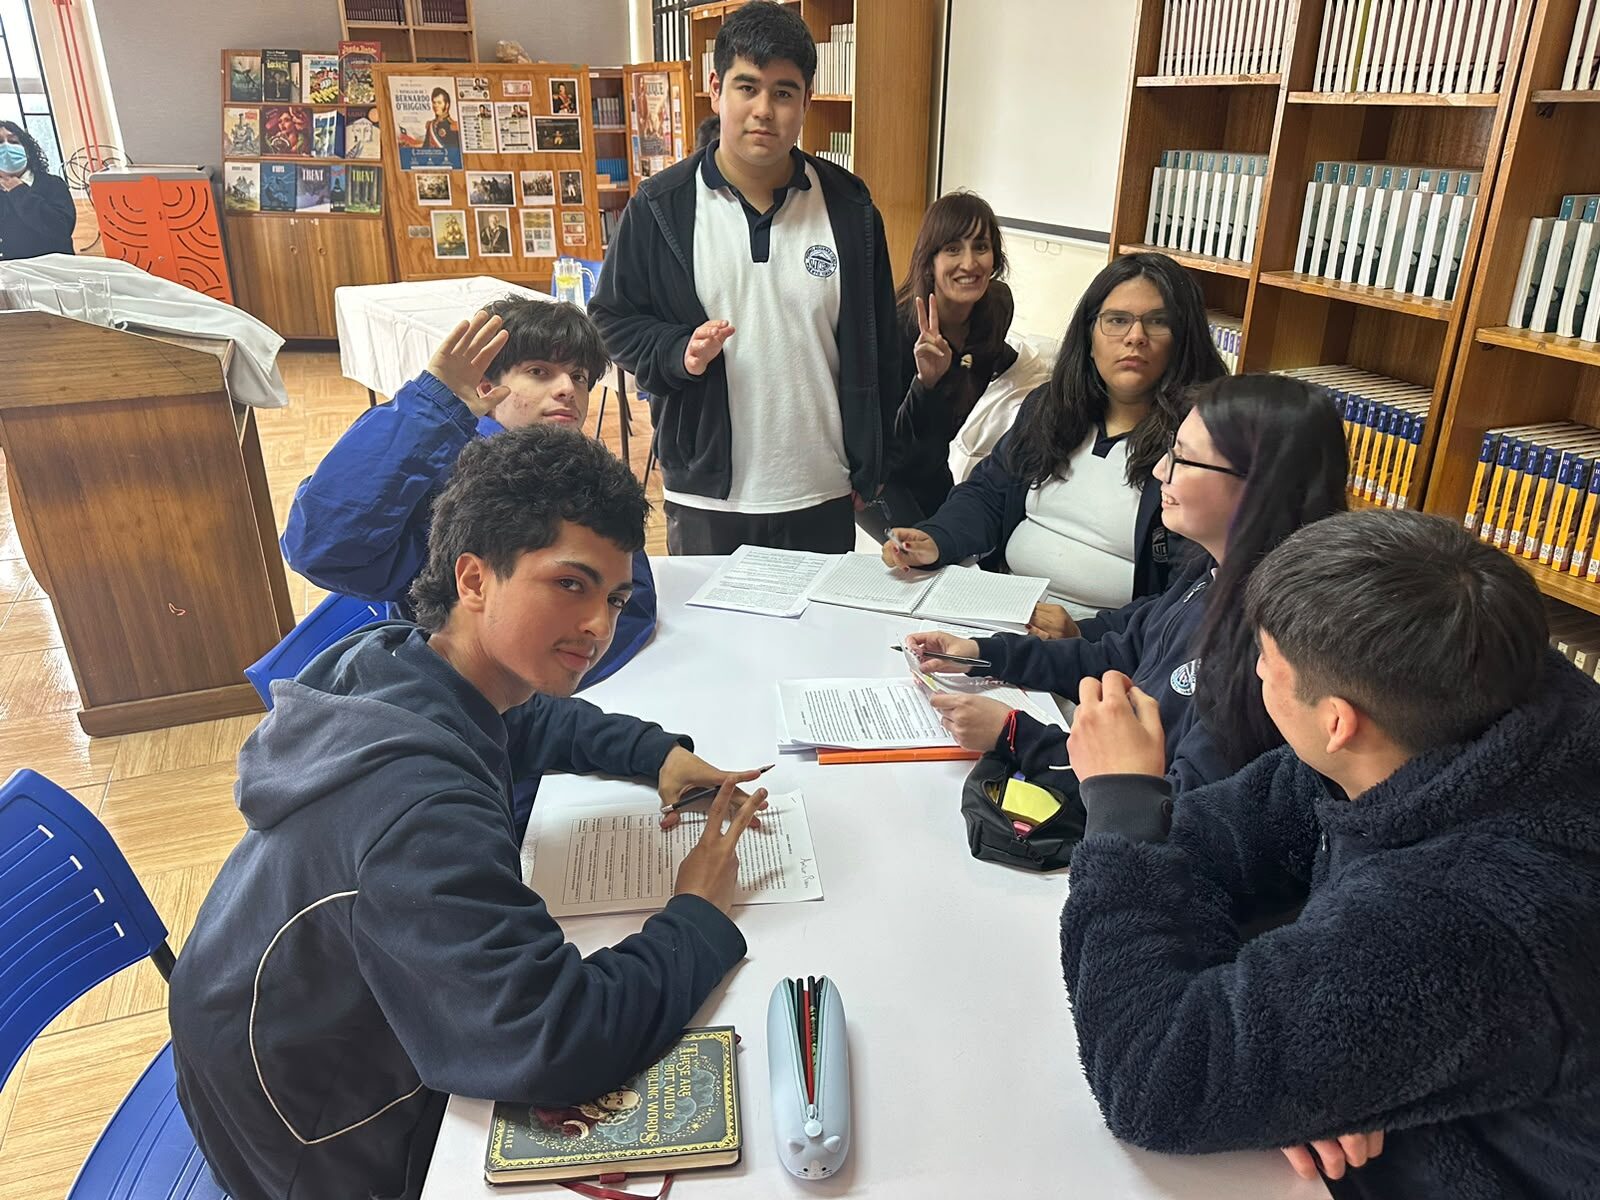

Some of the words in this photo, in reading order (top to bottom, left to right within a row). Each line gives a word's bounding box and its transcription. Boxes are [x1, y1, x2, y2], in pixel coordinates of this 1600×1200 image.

[395, 94, 430, 102] BERNARDO
[396, 102, 431, 111] O'HIGGINS
[301, 168, 324, 182] TRENT
[352, 169, 375, 182] TRENT
[676, 1043, 698, 1076] THESE
[646, 1063, 659, 1099] HIRLING
[664, 1064, 675, 1082] BUT
[677, 1078, 691, 1097] ARE
[664, 1084, 675, 1110] WILD
[640, 1101, 660, 1143] WORDS
[664, 1112, 675, 1120] &
